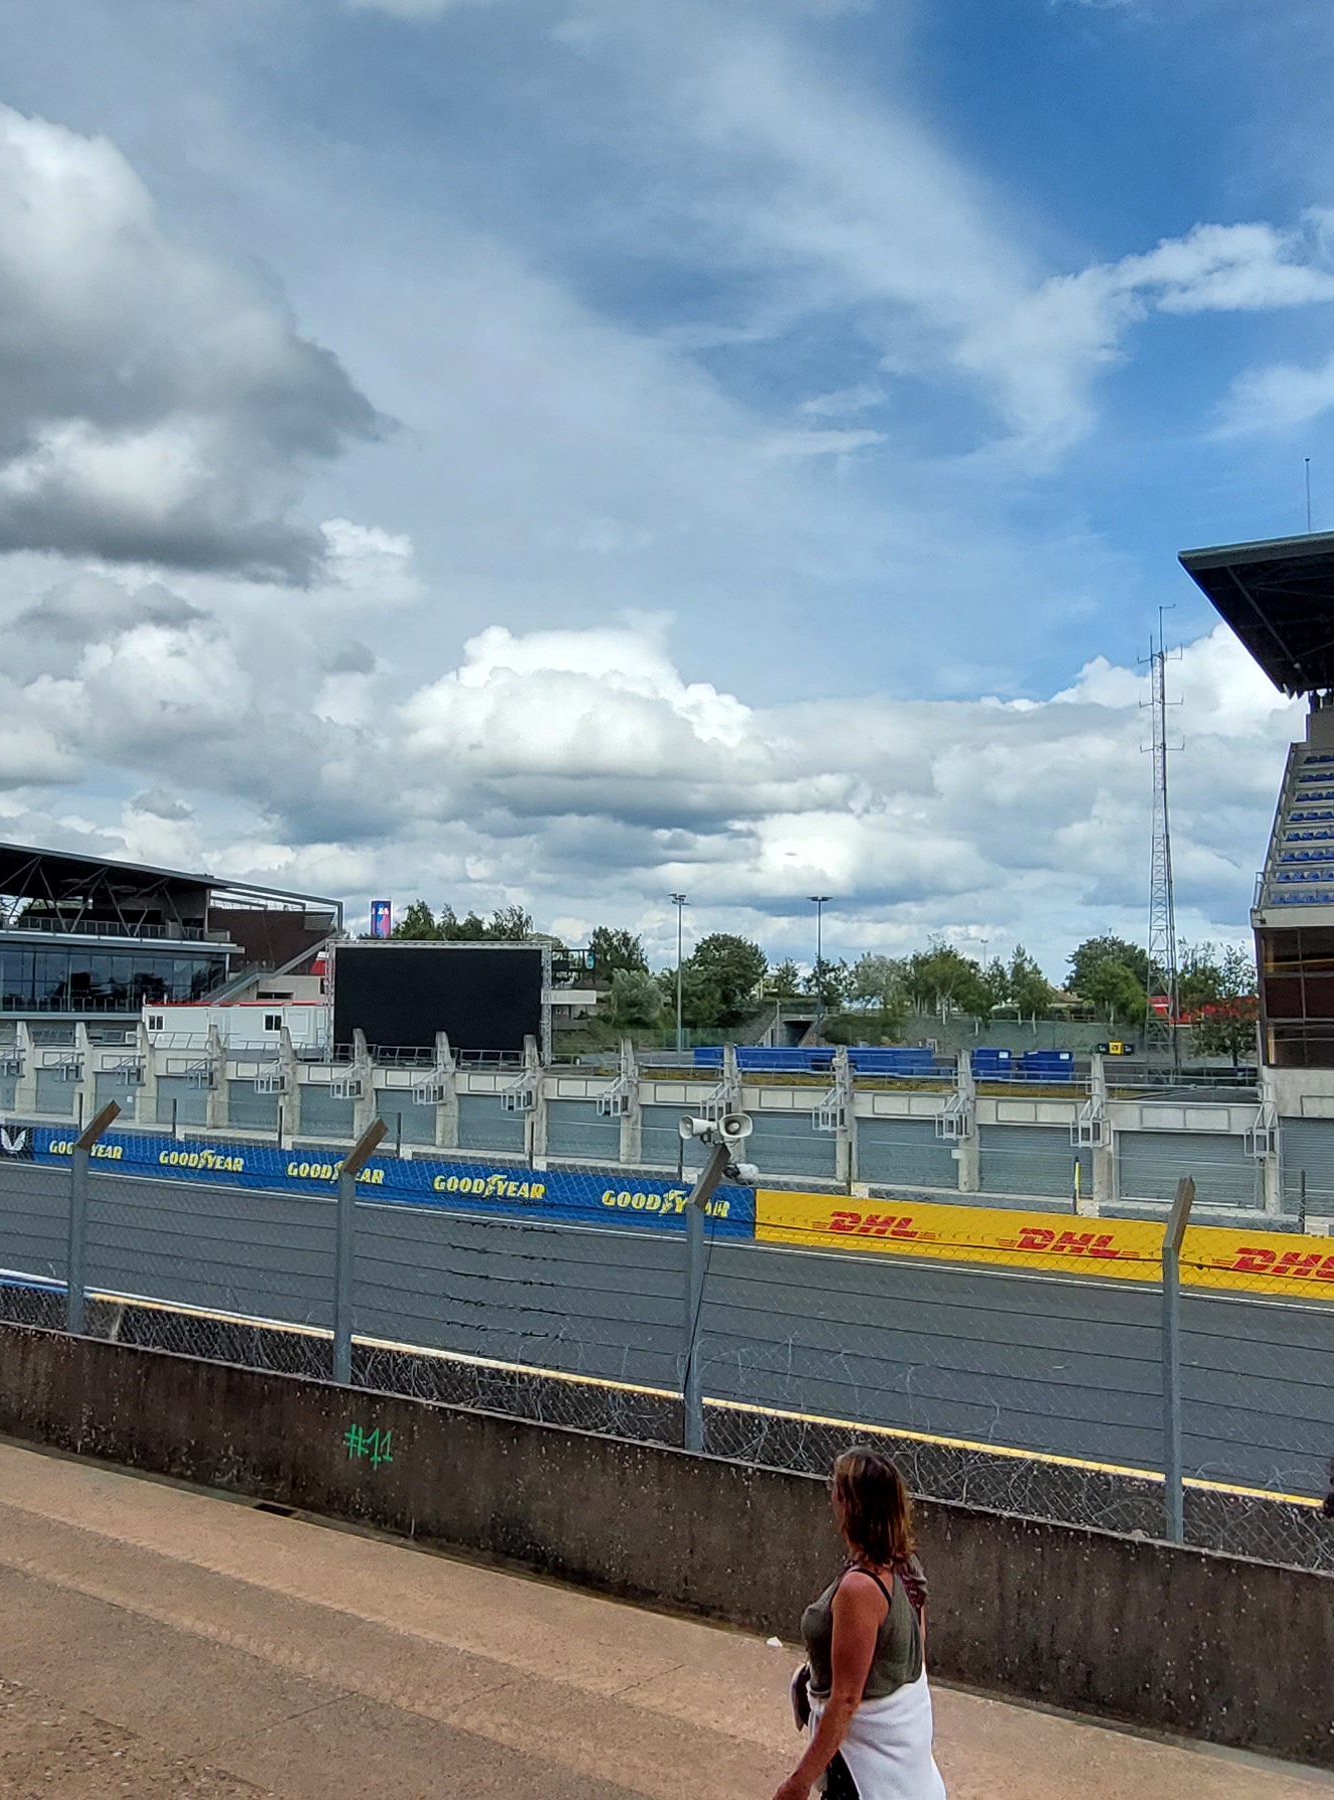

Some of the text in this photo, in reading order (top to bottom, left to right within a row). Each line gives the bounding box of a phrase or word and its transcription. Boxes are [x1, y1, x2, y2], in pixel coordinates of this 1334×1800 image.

[159, 1149, 244, 1172] GOODYEAR
[287, 1161, 384, 1185] GOODAR
[433, 1174, 546, 1200] GOODYEAR
[828, 1211, 919, 1239] DHL
[1016, 1227, 1120, 1258] DHL
[343, 1424, 393, 1470] #11
